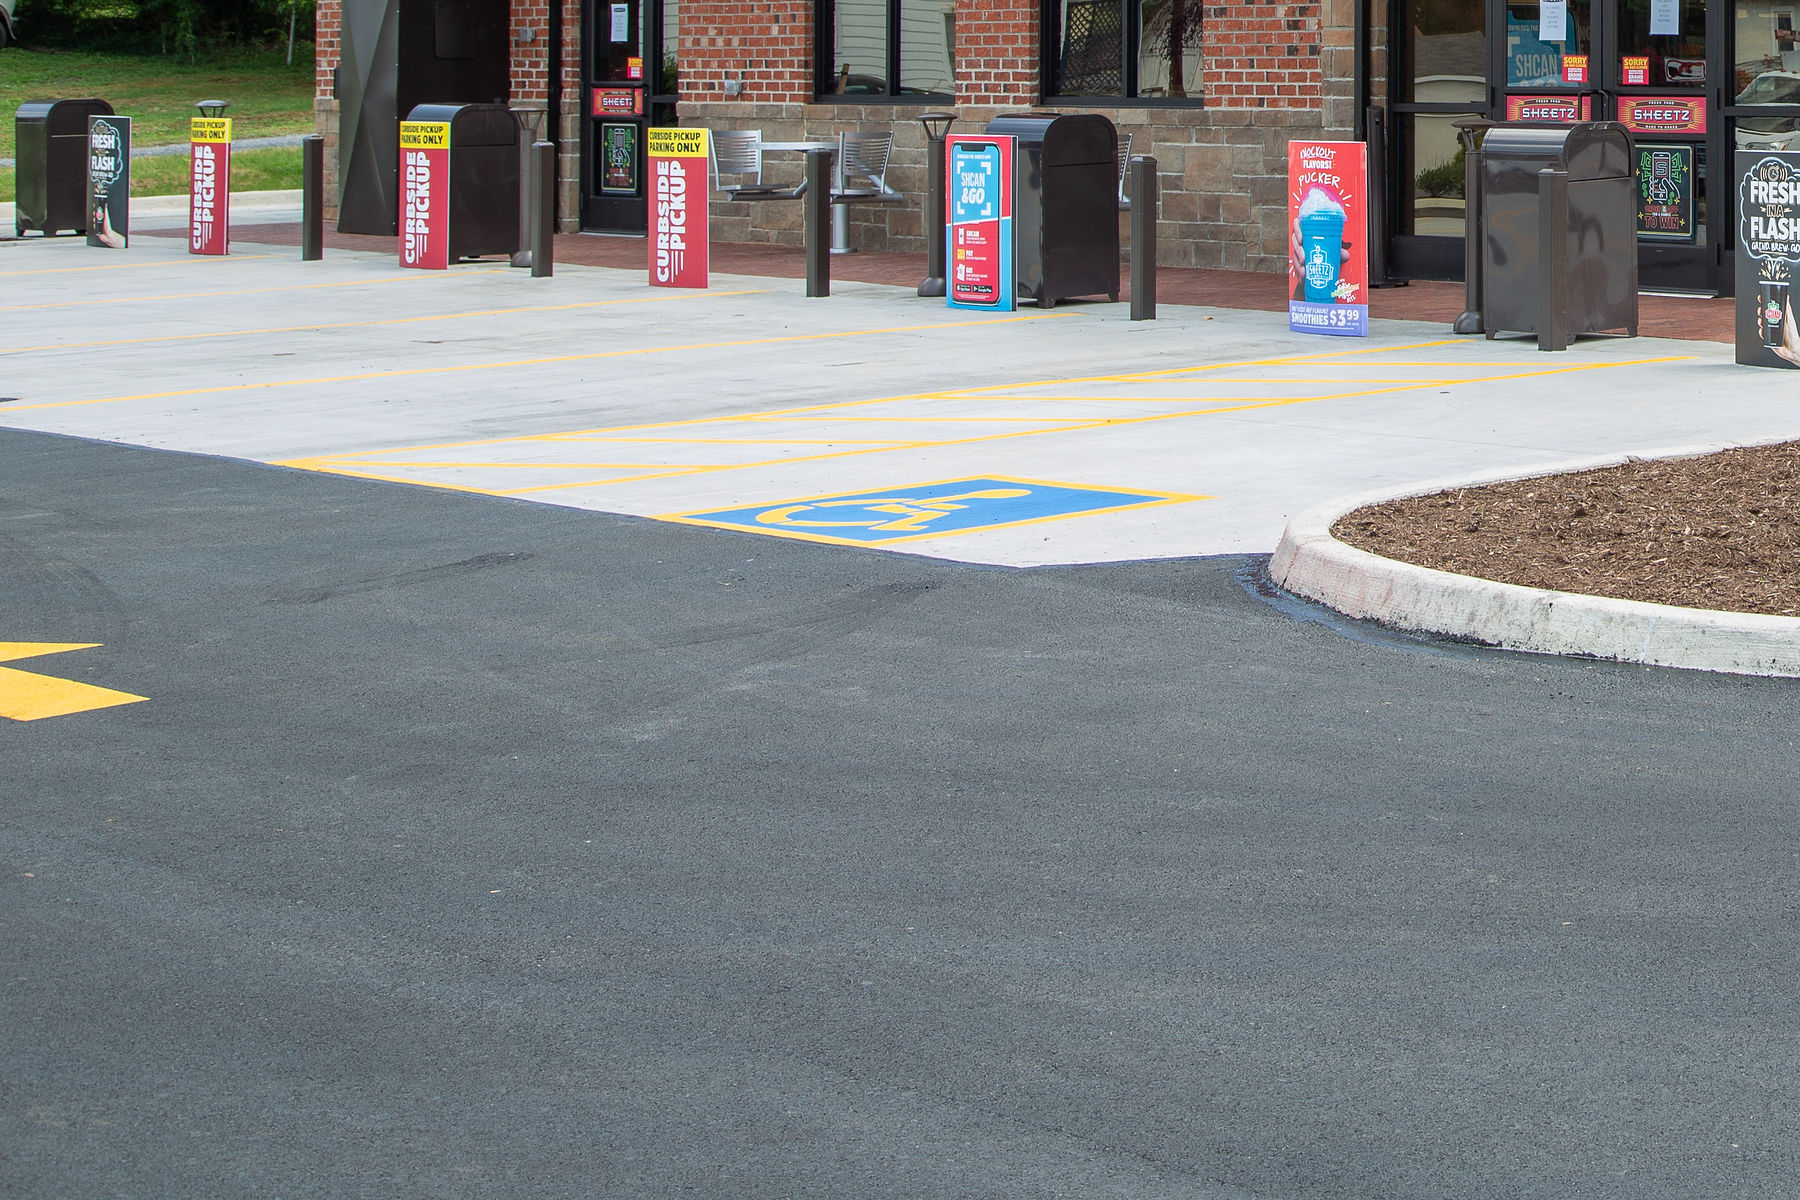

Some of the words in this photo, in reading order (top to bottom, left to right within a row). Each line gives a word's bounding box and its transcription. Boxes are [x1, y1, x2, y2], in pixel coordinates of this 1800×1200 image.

[1508, 24, 1529, 32] OWNLOAD
[1515, 54, 1558, 78] SHCAN
[1564, 56, 1587, 64] SORRY
[1624, 58, 1648, 66] SORRY
[1522, 108, 1576, 119] SHEETZ
[1634, 110, 1691, 121] SHEETZ
[208, 130, 226, 139] ONLY
[420, 125, 443, 134] PICKUP
[650, 131, 673, 141] CURBSIDE
[673, 132, 700, 141] PICKUP
[91, 134, 115, 149] FRESH
[422, 135, 443, 145] ONLY
[649, 141, 675, 152] PARKING
[676, 142, 700, 153] ONLY
[1300, 145, 1337, 160] KNOCKOUT
[91, 155, 115, 171] FLASH
[1302, 159, 1332, 170] FLAVORS!
[202, 145, 215, 223] PICKUP
[961, 171, 985, 188] SHCAN
[1298, 171, 1341, 188] PUCKER
[193, 146, 203, 250] CURBSIDE
[415, 151, 431, 234] PICKUP
[961, 187, 985, 204] &GO
[405, 151, 416, 264] CURBSIDE
[669, 160, 686, 250] PICKUP
[656, 160, 669, 283] CURBSIDE
[1644, 216, 1657, 228] TO
[1660, 216, 1679, 229] WIN
[1291, 311, 1329, 326] SMOOTHIES
